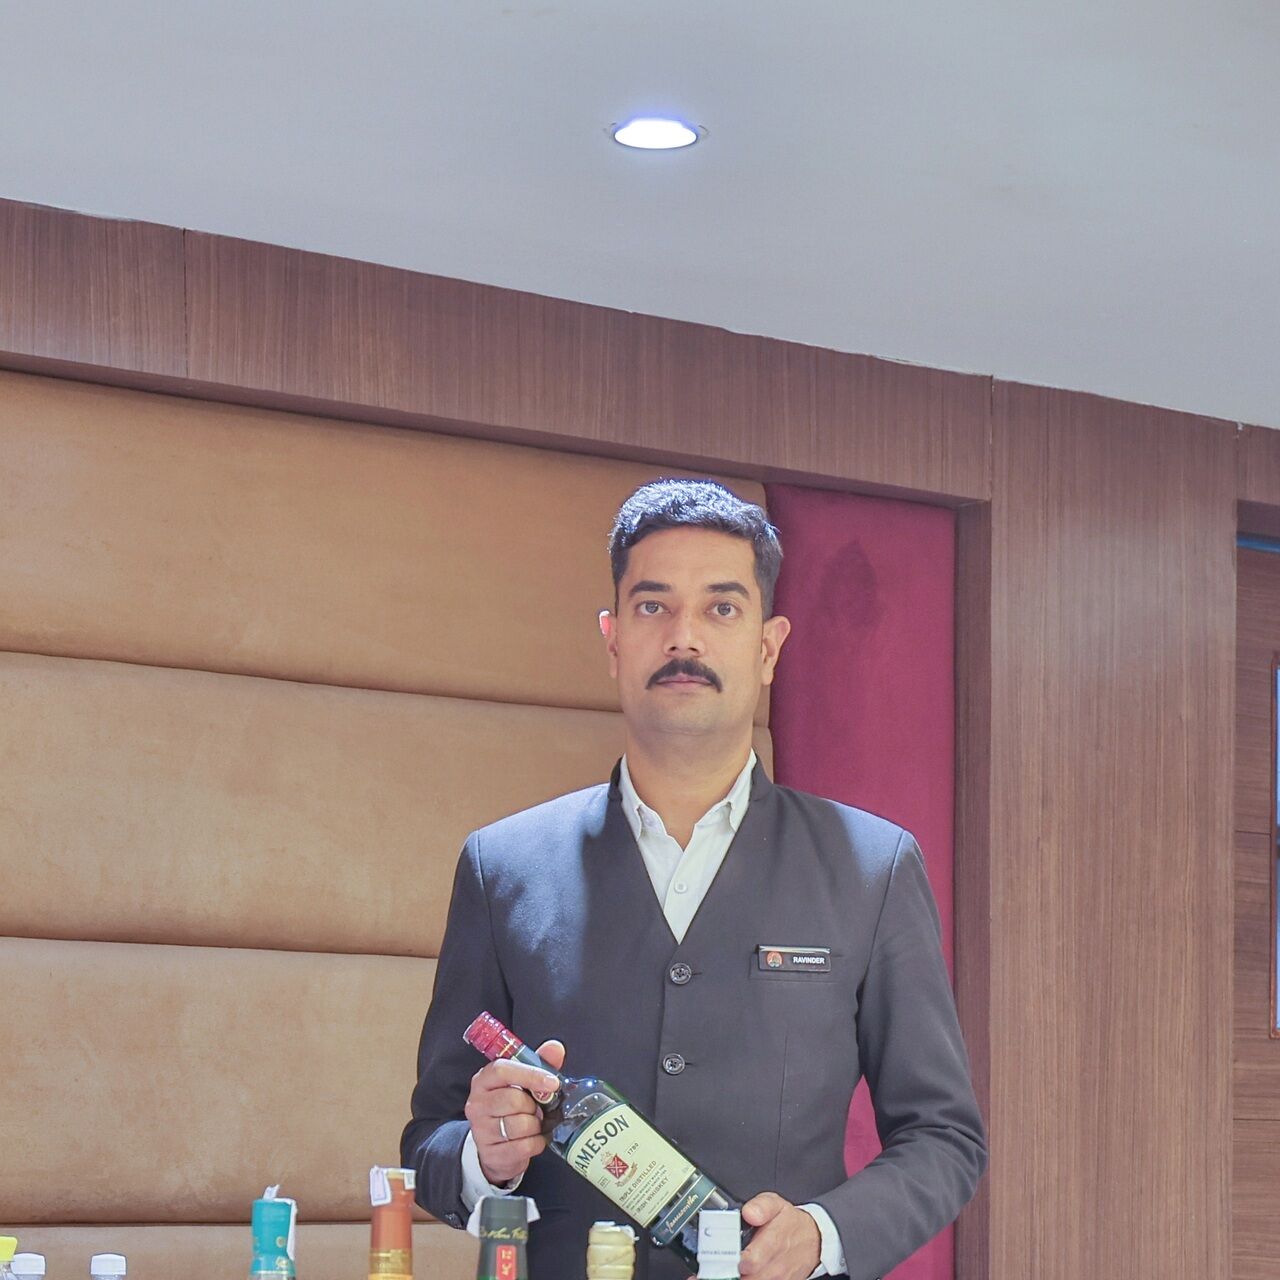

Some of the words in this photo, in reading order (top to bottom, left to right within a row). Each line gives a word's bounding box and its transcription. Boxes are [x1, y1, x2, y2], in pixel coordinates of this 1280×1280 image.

[792, 956, 825, 965] RAVINDER
[574, 1114, 630, 1178] JAMESON
[631, 1160, 657, 1189] DISTILLED
[646, 1176, 669, 1201] WHISKEY
